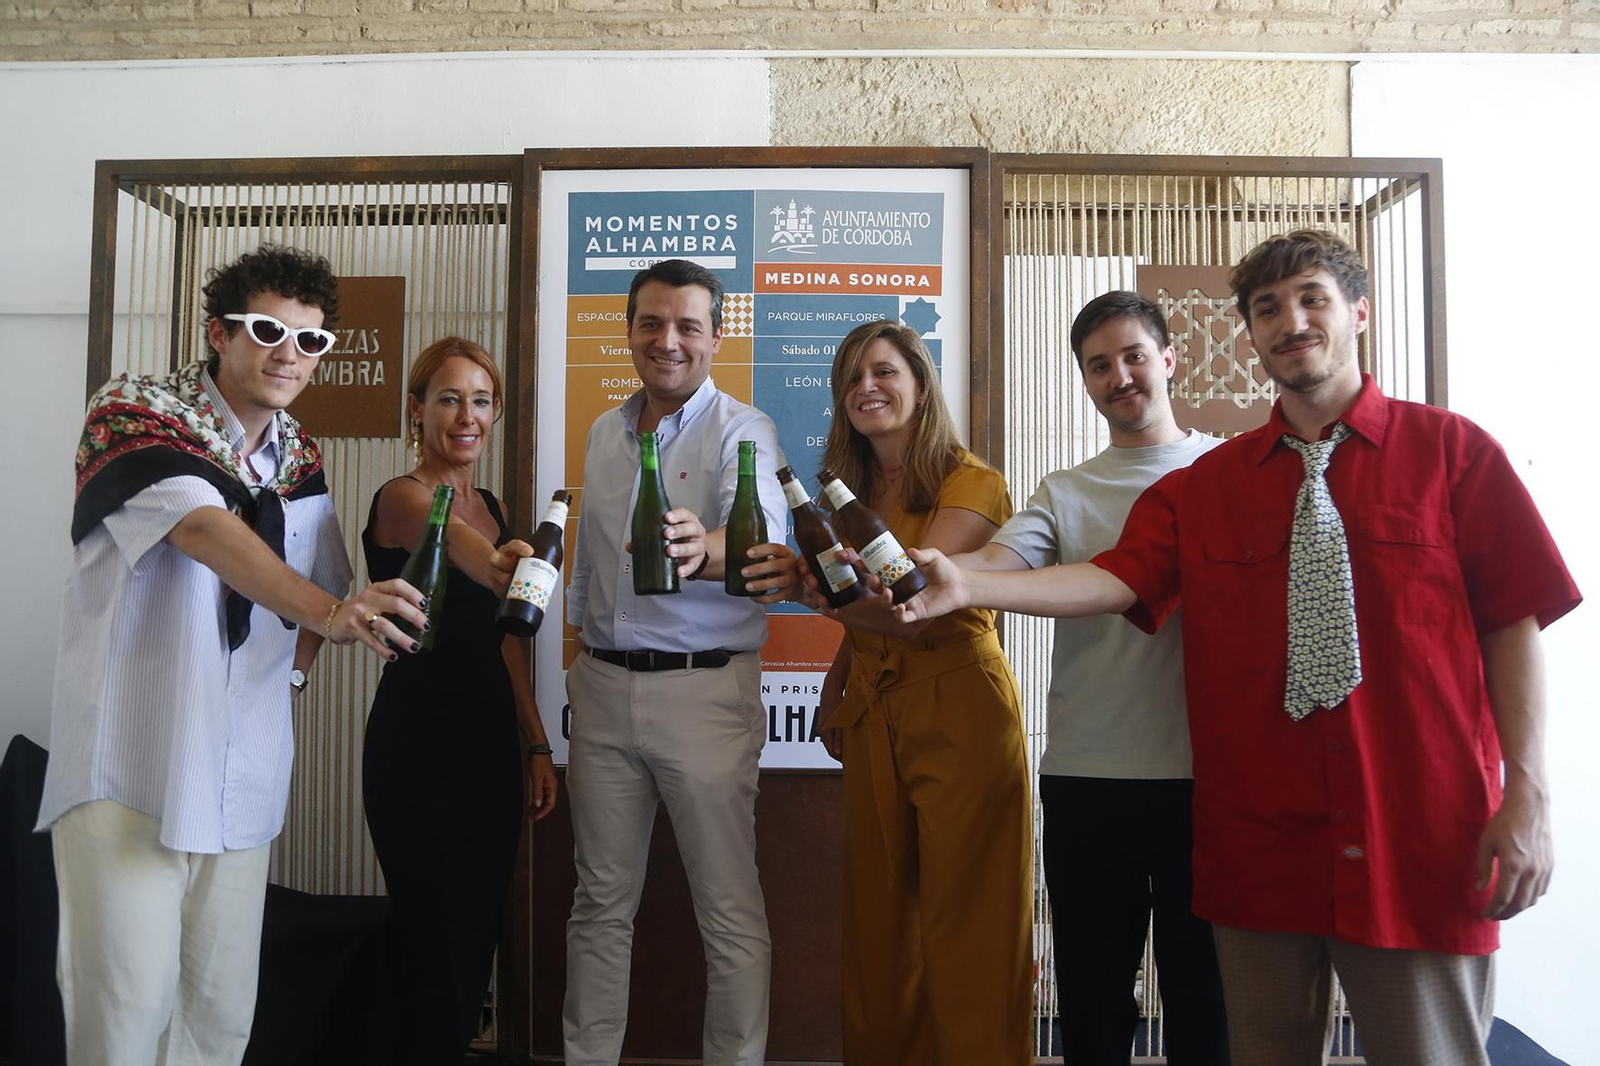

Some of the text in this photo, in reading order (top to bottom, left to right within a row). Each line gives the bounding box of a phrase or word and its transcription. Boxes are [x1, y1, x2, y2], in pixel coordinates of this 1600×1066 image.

[585, 214, 738, 232] MOMENTOS
[822, 210, 931, 229] AYUNTAMIENTO
[585, 235, 737, 253] ALHAMBRA
[822, 226, 913, 246] DE CÓRDOBA
[765, 273, 930, 287] MEDINA SONORA
[767, 312, 885, 322] PARQUE MIRAFLORES
[782, 345, 836, 355] Sábado 01
[785, 375, 822, 388] LEÓN
